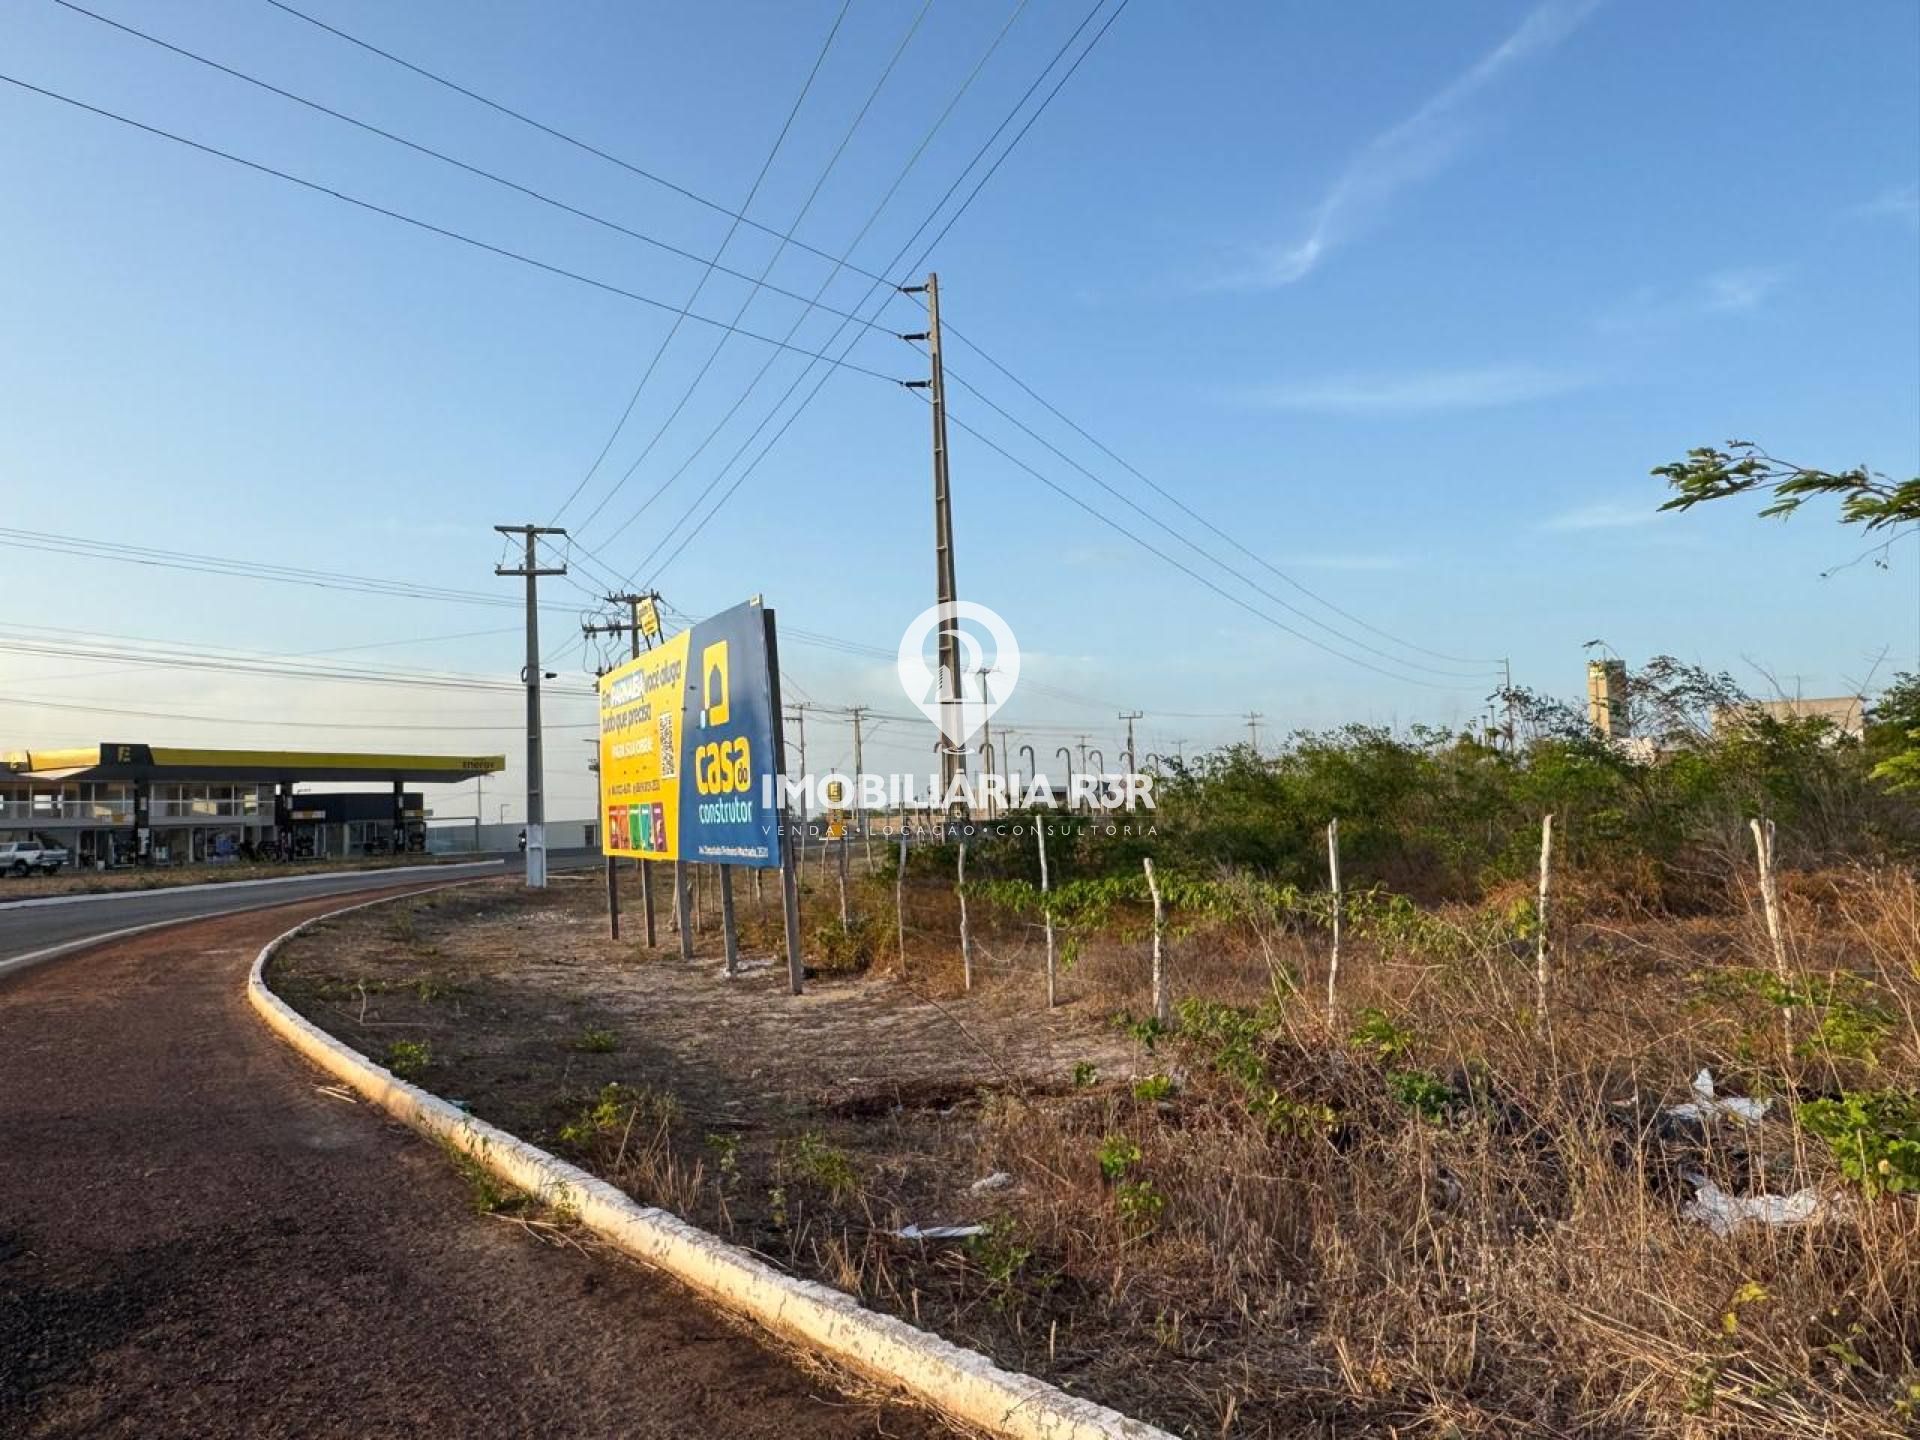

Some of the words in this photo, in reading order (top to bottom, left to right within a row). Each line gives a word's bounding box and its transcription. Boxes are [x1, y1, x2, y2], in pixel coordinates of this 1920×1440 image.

[695, 736, 751, 795] casa
[737, 761, 748, 784] do
[698, 795, 754, 825] construtor
